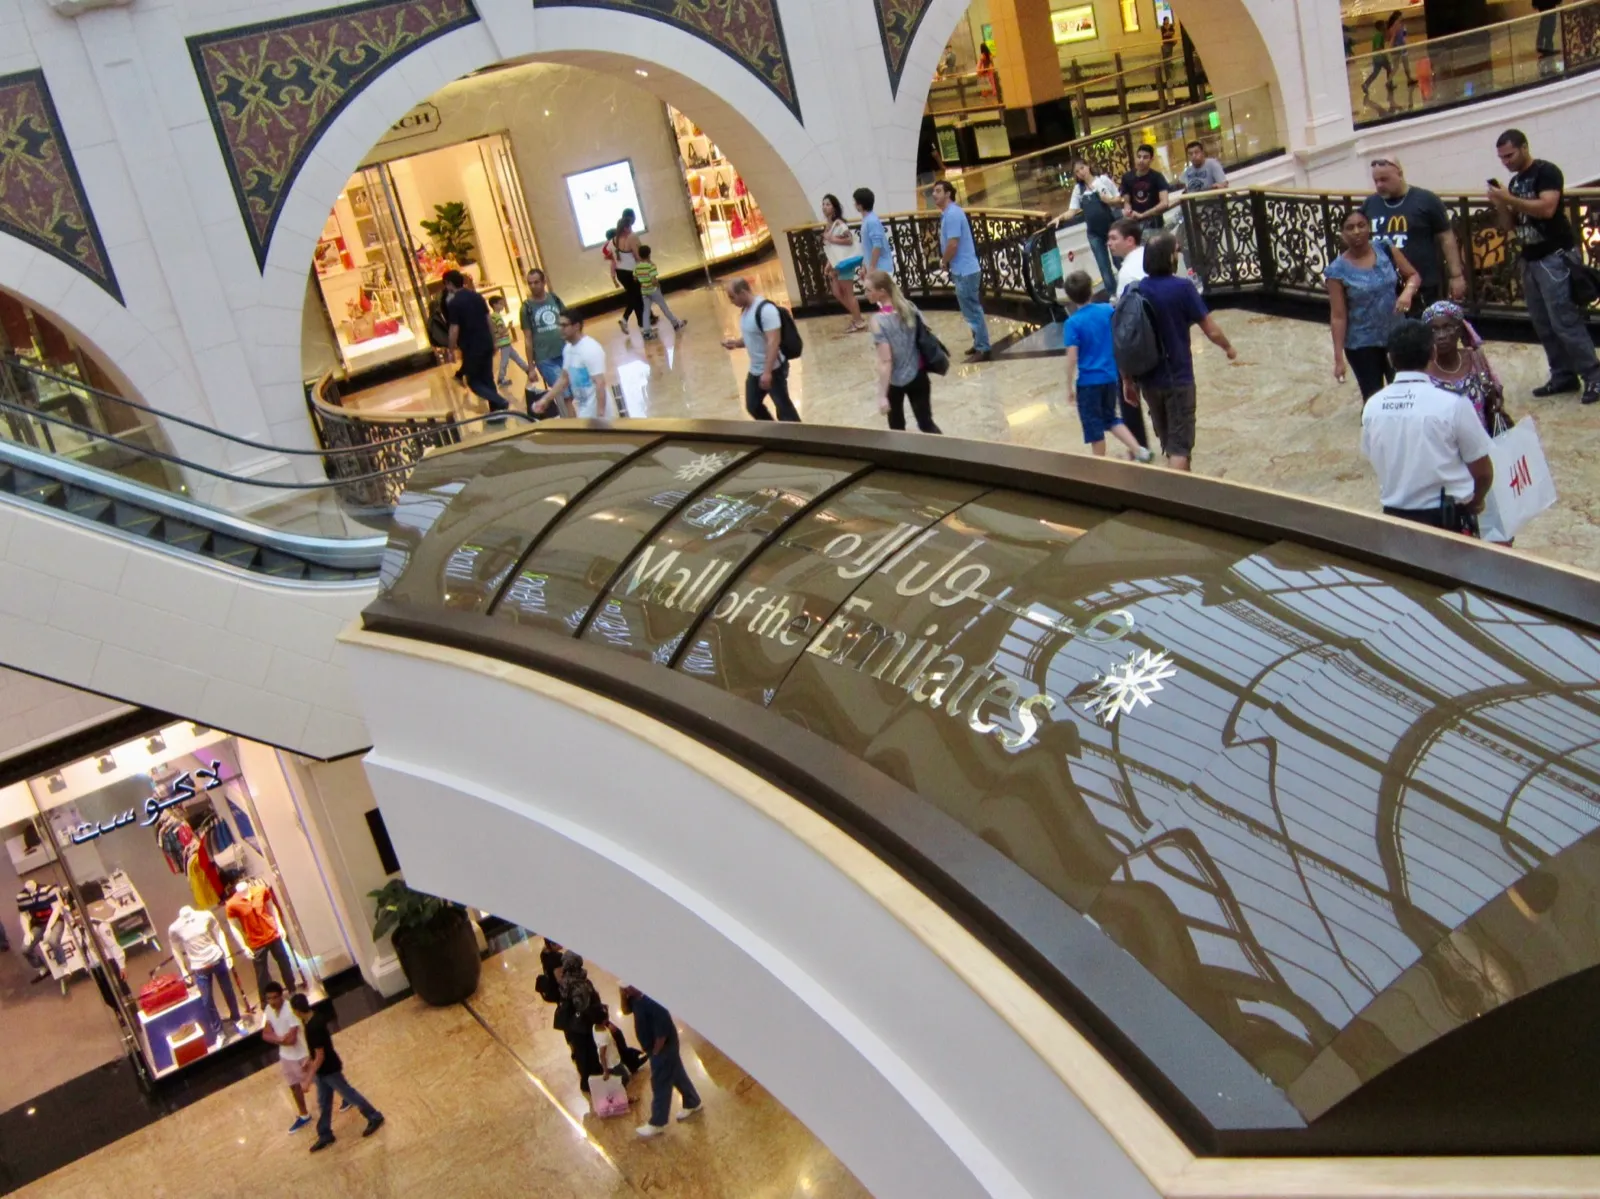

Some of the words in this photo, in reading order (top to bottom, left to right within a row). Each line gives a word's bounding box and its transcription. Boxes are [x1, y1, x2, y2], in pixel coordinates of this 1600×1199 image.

[391, 112, 430, 131] CH
[1382, 401, 1415, 411] SECURITY
[613, 545, 734, 613] Mall
[713, 586, 765, 624] of
[748, 593, 812, 646] the
[806, 597, 1056, 751] Emirates
[71, 759, 223, 844] لاكوست
